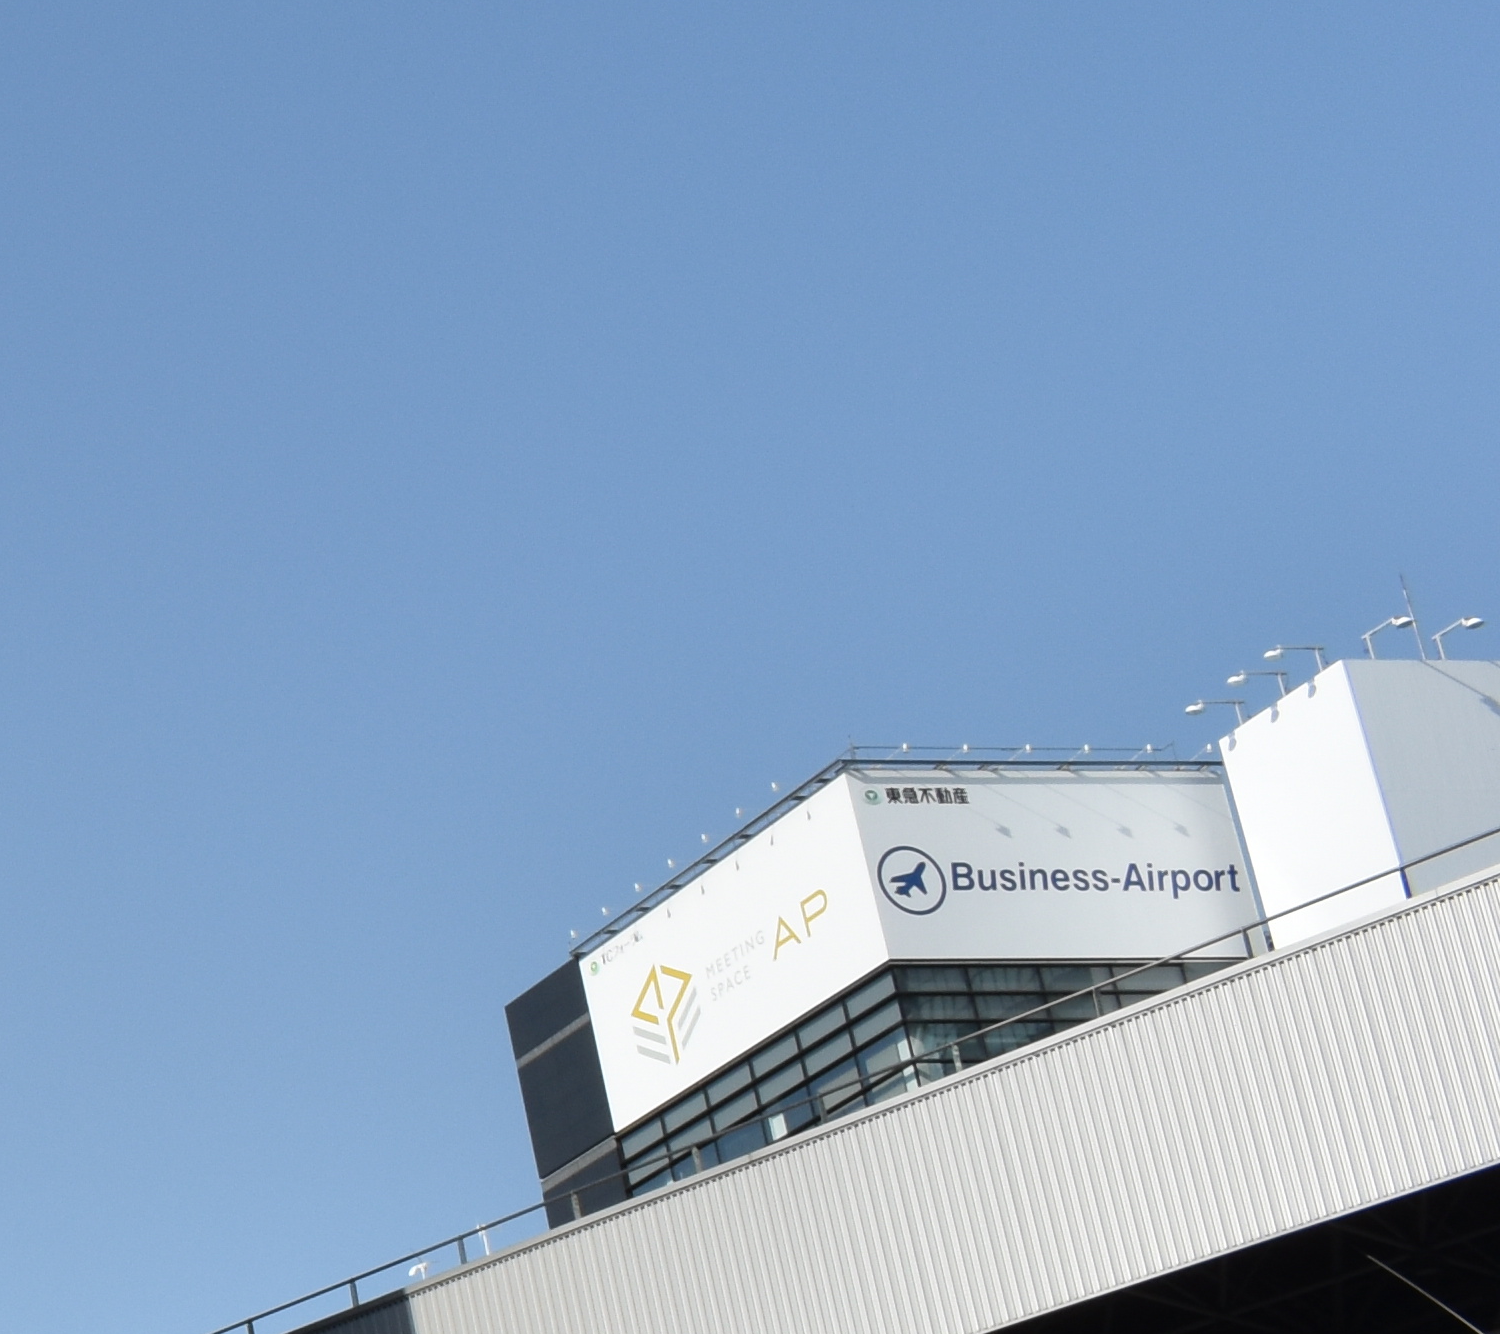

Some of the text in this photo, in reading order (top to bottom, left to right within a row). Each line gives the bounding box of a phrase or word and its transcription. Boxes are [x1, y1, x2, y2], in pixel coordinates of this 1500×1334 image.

[884, 787, 971, 806] 東急不動産
[950, 860, 1241, 900] Business-Airport
[771, 888, 829, 961] AP
[704, 929, 766, 980] MEETING
[710, 965, 752, 1002] SPACE
